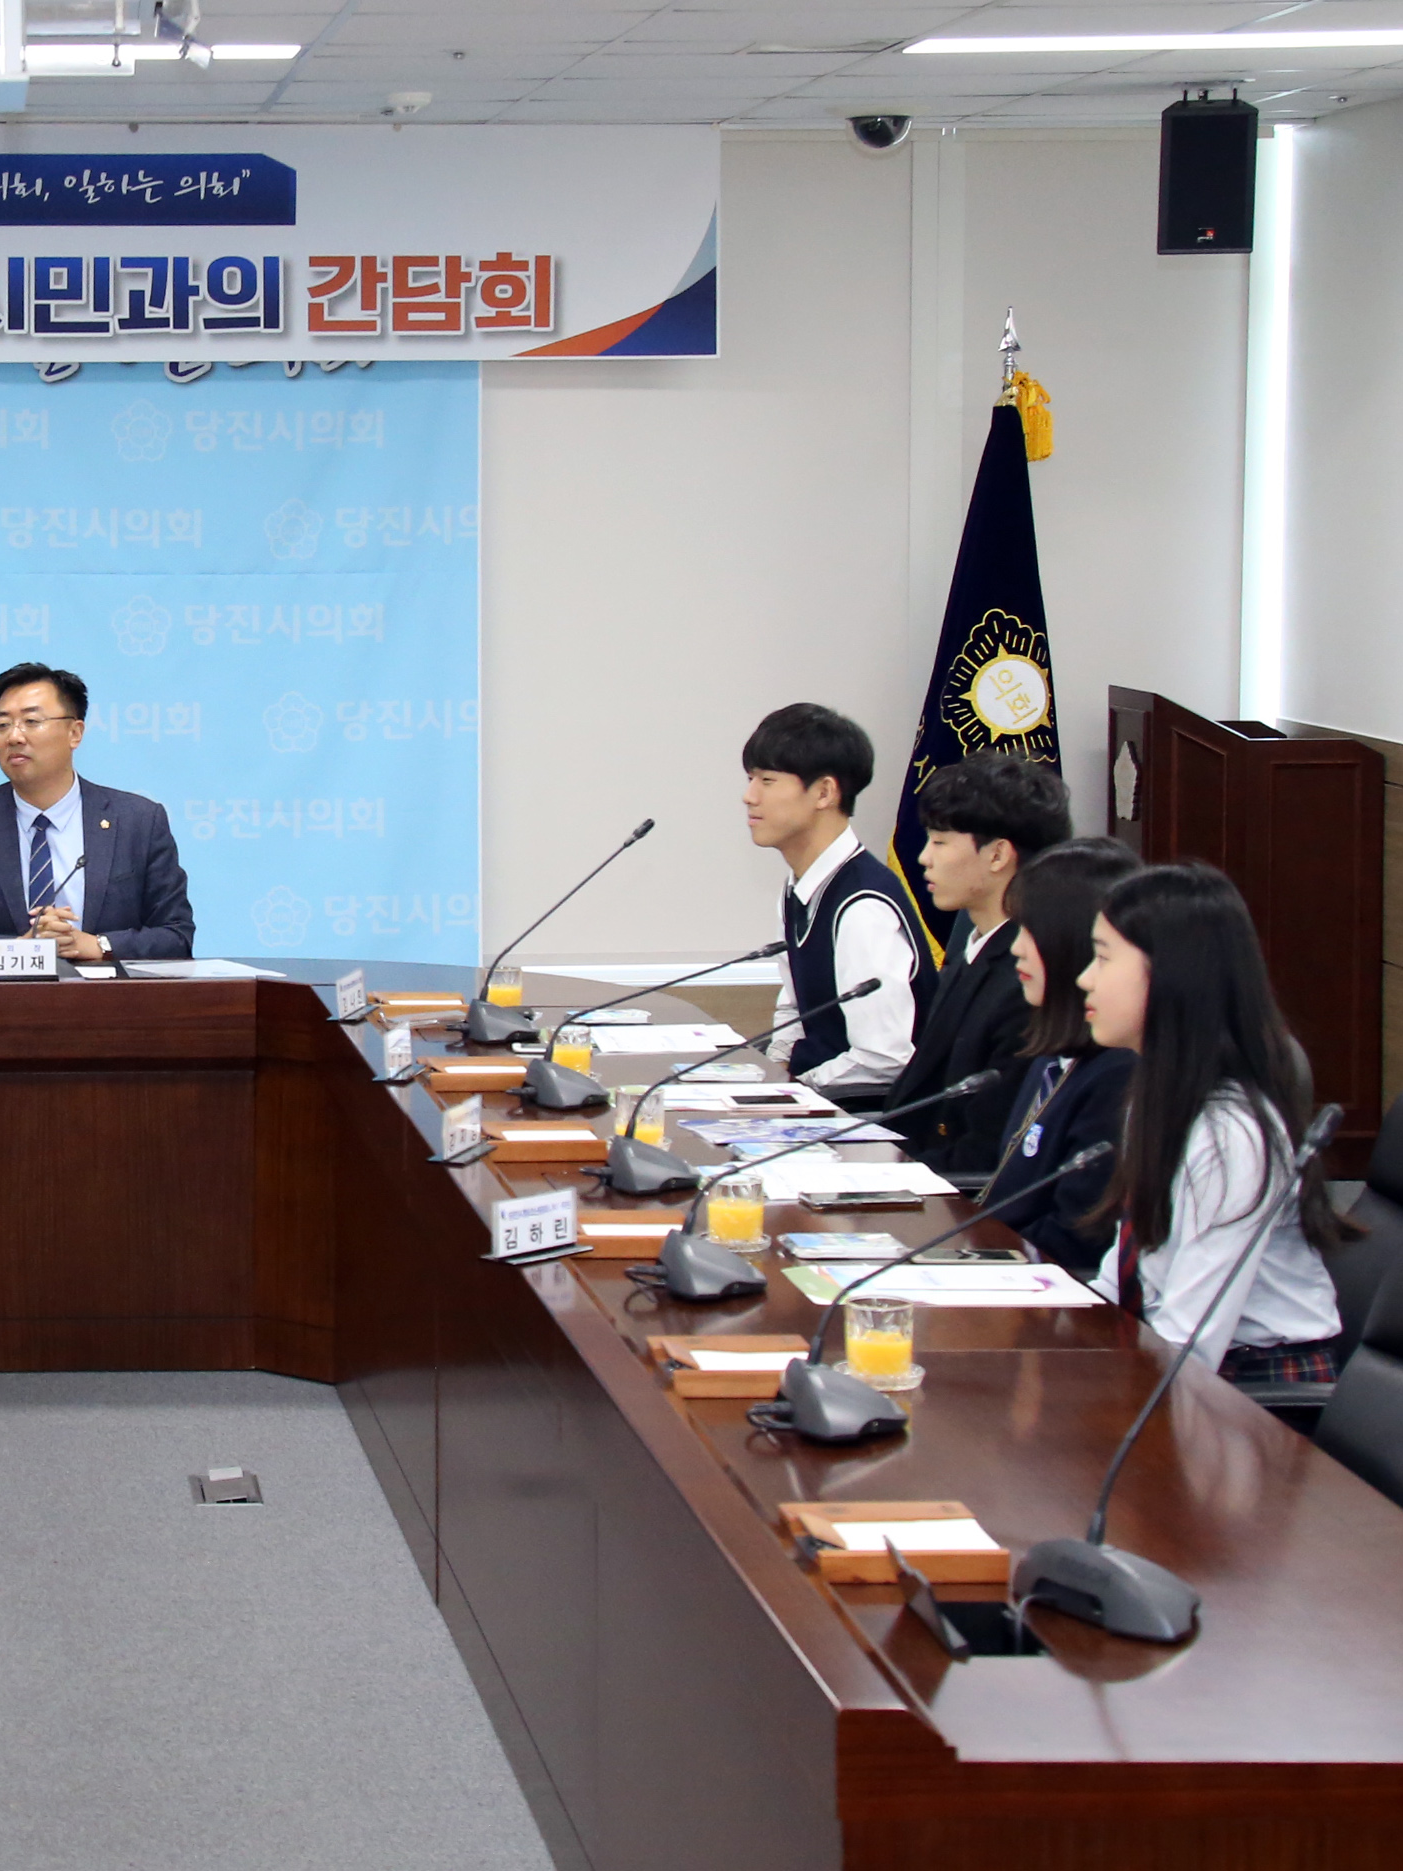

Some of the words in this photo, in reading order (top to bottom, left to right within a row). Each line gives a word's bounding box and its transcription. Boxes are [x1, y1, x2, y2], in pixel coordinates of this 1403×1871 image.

[64, 169, 164, 203] 일하는
[305, 250, 557, 336] 간담회
[184, 408, 385, 452] 당진시의회
[0, 507, 203, 550] 당진시의회
[184, 602, 385, 647] 당진시의회
[989, 668, 1038, 725] 의회
[86, 700, 202, 743] 시의회
[184, 797, 386, 841] 당진시의회
